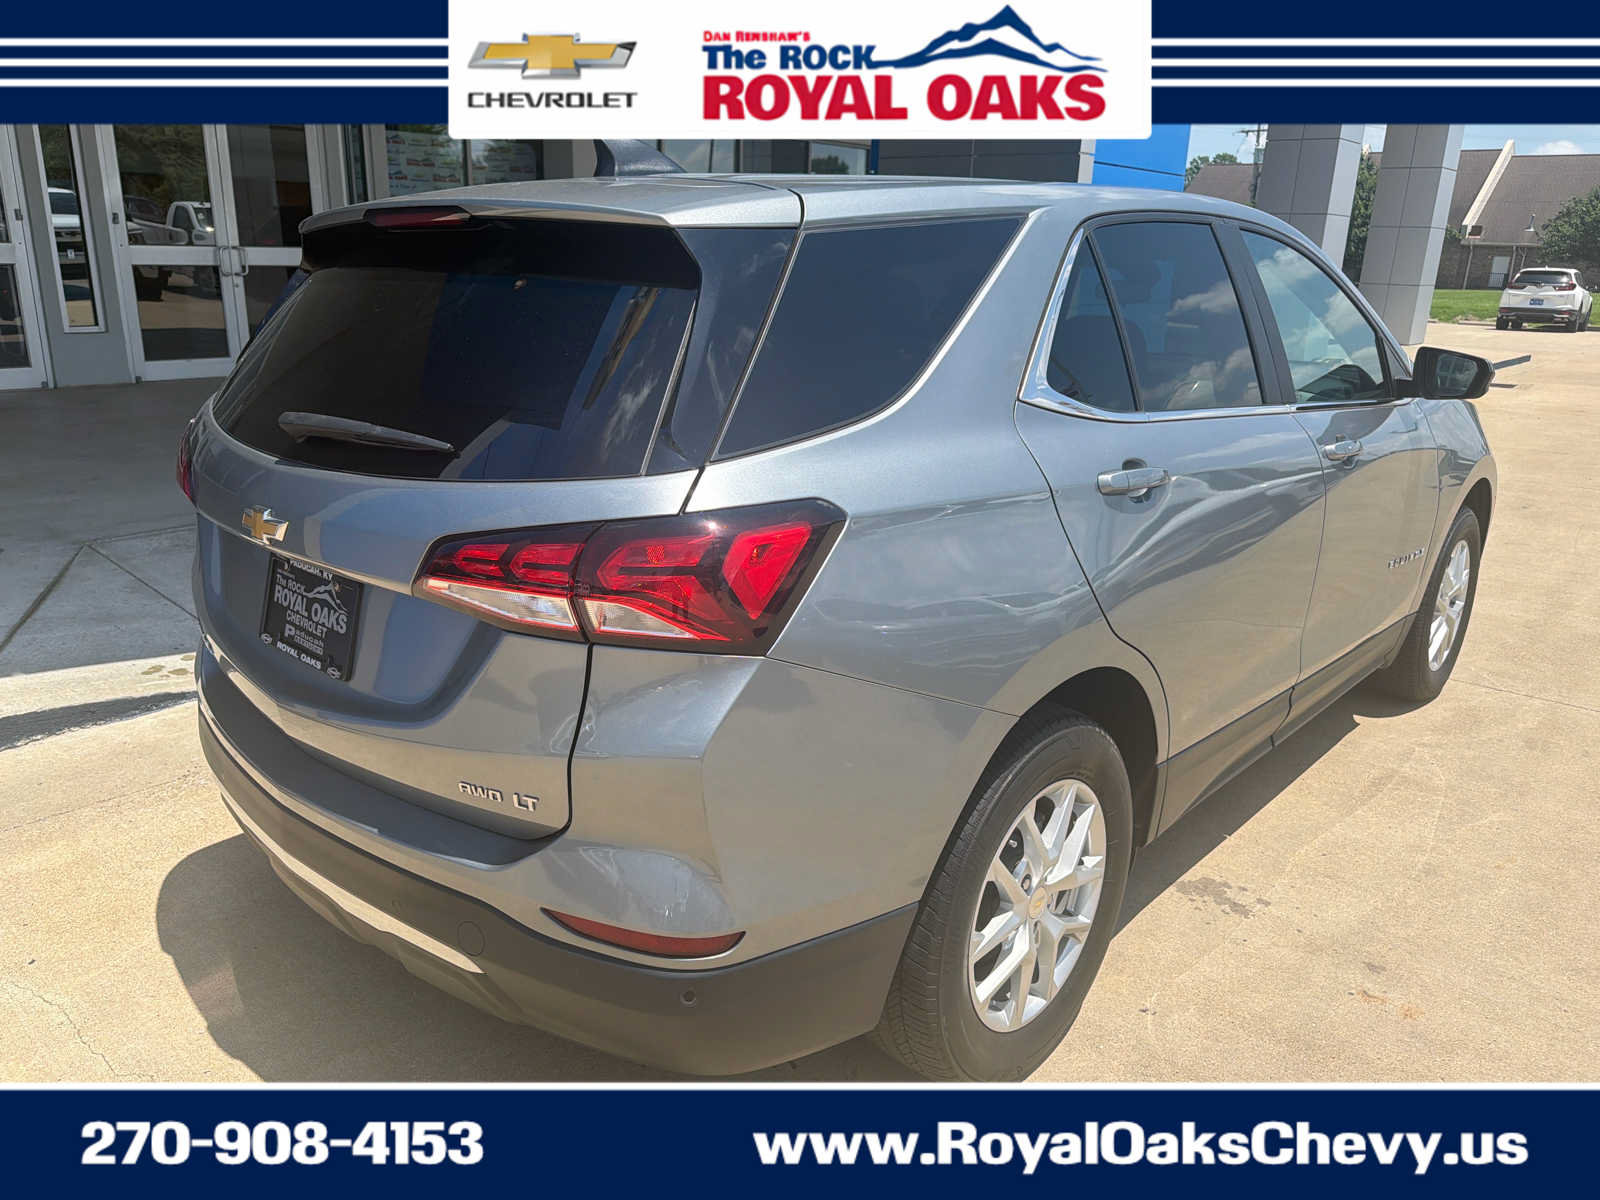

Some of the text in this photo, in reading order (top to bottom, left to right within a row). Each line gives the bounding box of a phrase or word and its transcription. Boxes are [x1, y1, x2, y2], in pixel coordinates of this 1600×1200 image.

[287, 579, 305, 594] ROCK
[274, 584, 348, 634] ROYAL OAKS
[286, 609, 328, 639] CHEVROLET
[276, 641, 299, 658] ROYAL
[300, 653, 322, 670] OAKS
[458, 780, 540, 812] AWD LT
